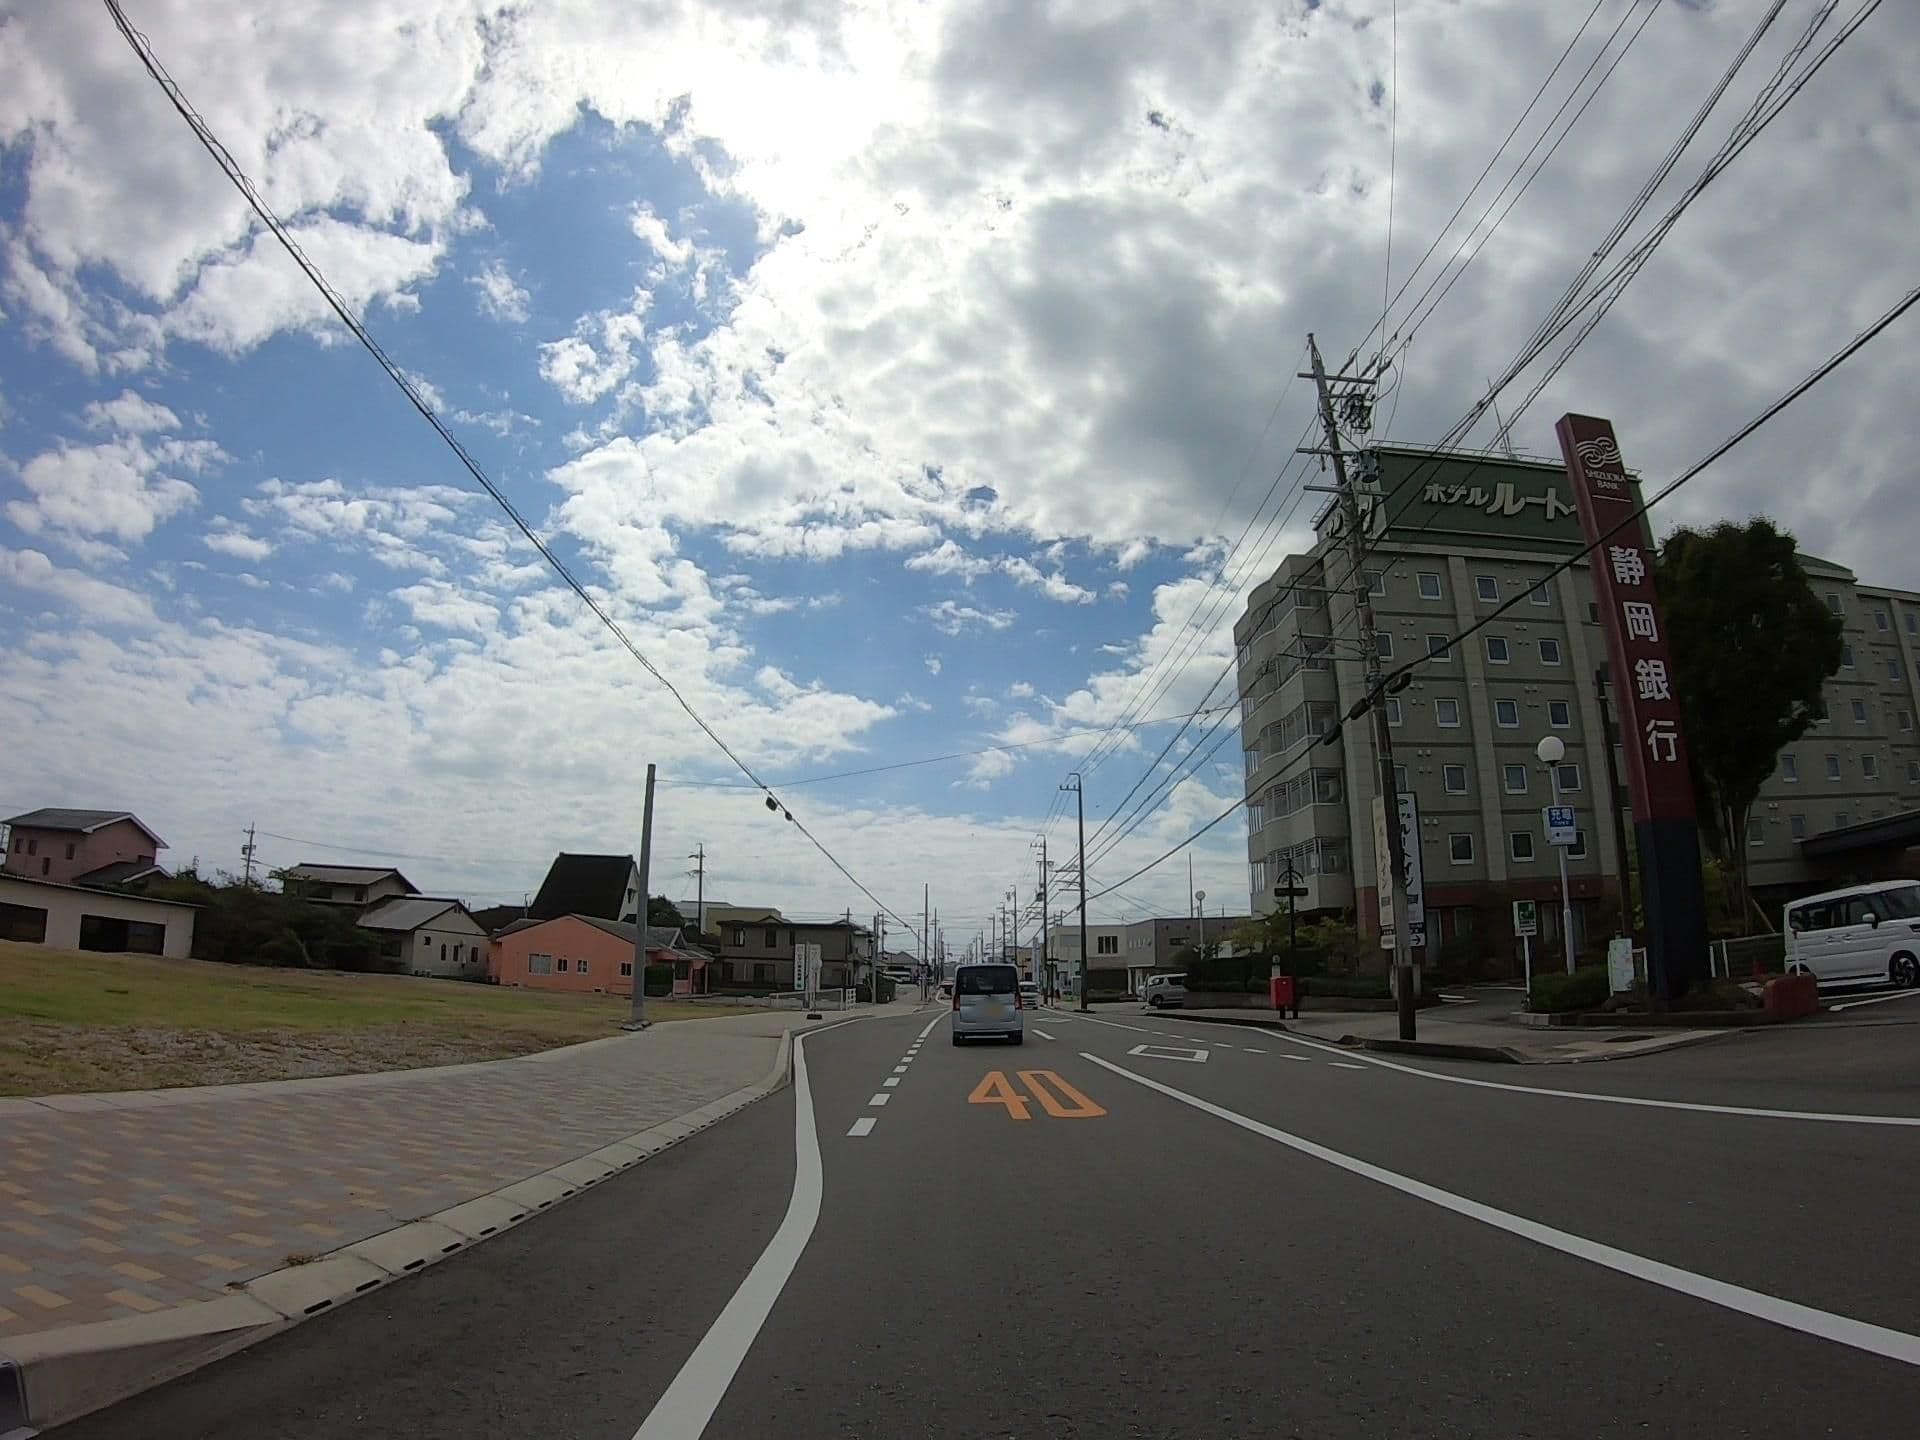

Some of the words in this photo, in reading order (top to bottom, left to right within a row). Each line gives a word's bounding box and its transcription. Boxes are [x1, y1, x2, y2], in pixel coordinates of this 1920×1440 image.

[1423, 482, 1577, 520] ホテルルート
[1609, 545, 1678, 762] 静岡銀行
[967, 1070, 1108, 1120] 40
